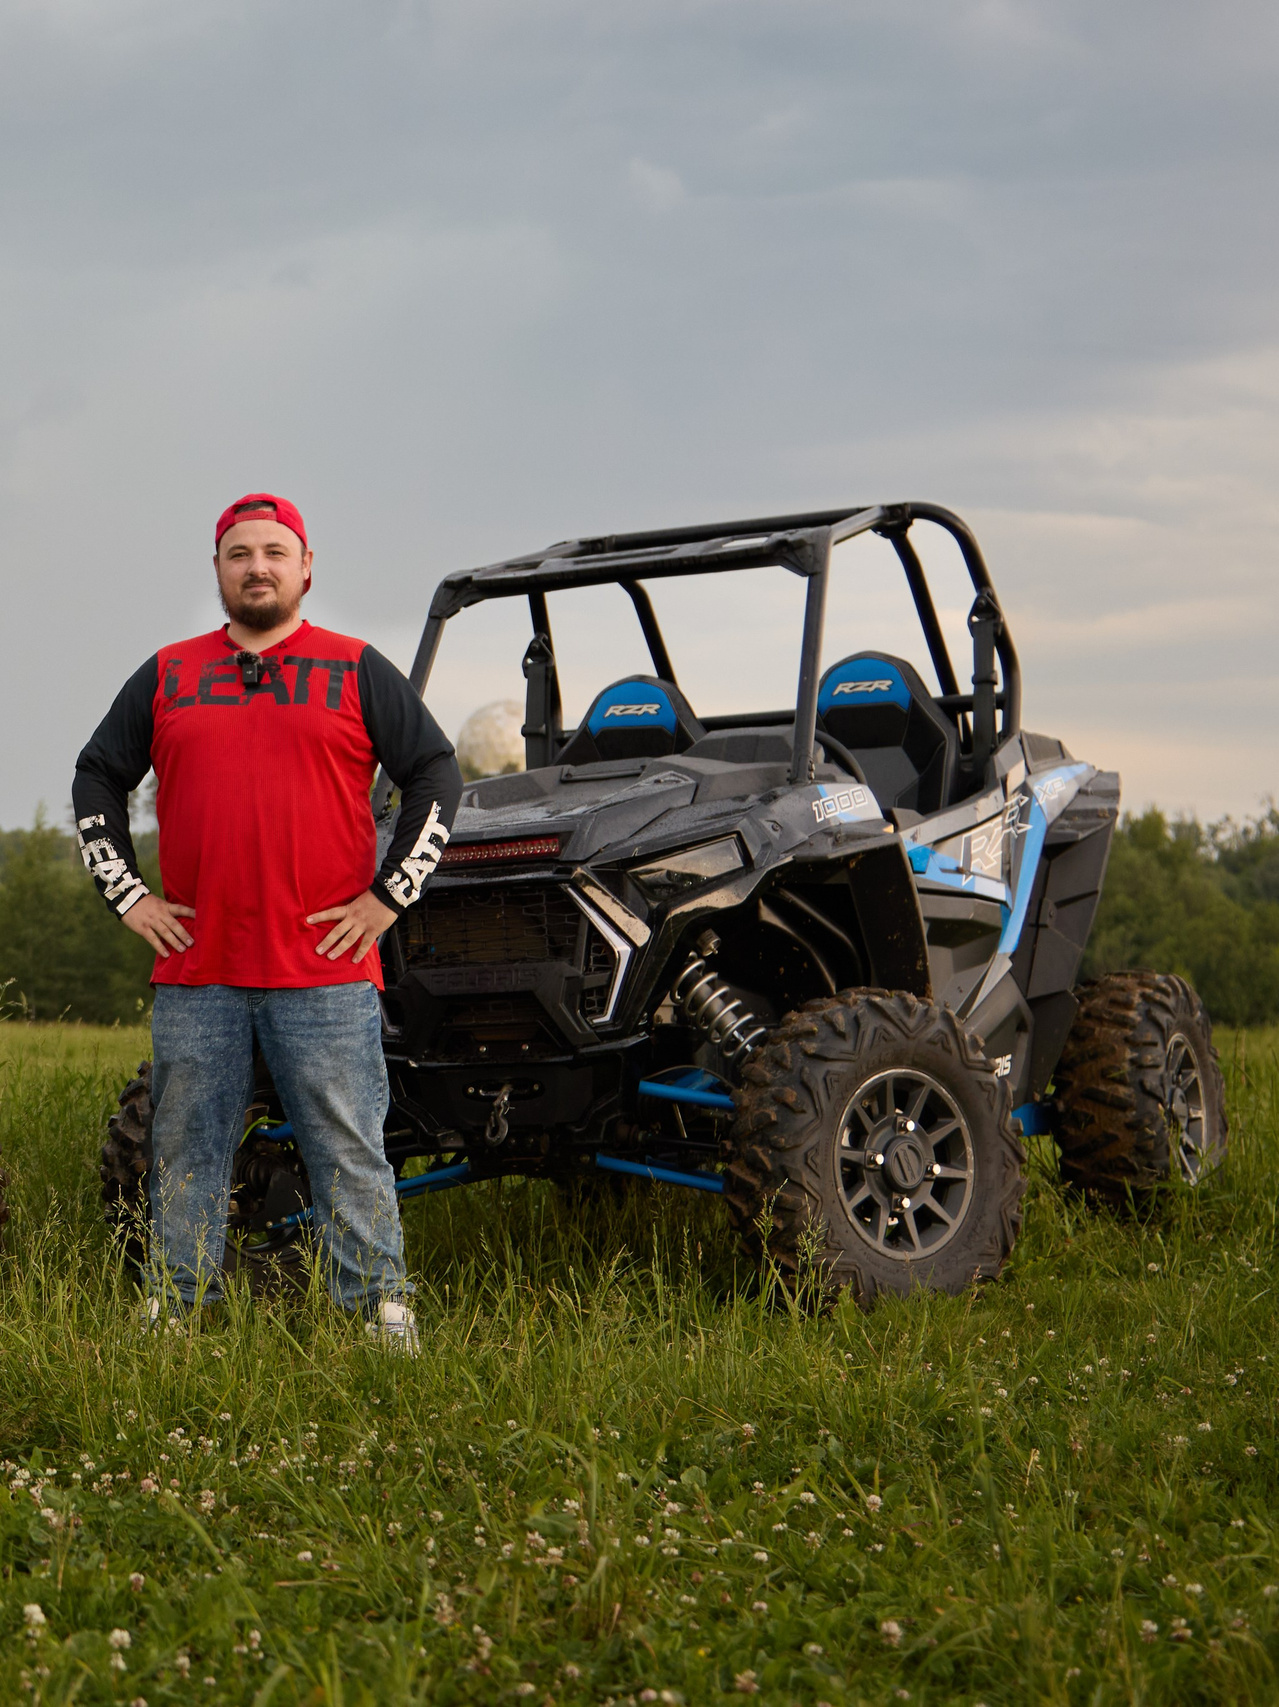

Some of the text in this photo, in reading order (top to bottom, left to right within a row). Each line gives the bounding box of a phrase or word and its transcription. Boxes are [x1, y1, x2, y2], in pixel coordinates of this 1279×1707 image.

[164, 655, 357, 712] LEATT
[832, 680, 893, 696] RZR
[603, 703, 661, 718] RZR
[812, 786, 868, 823] 1000
[1033, 776, 1066, 806] XP
[77, 814, 150, 915] LEATT
